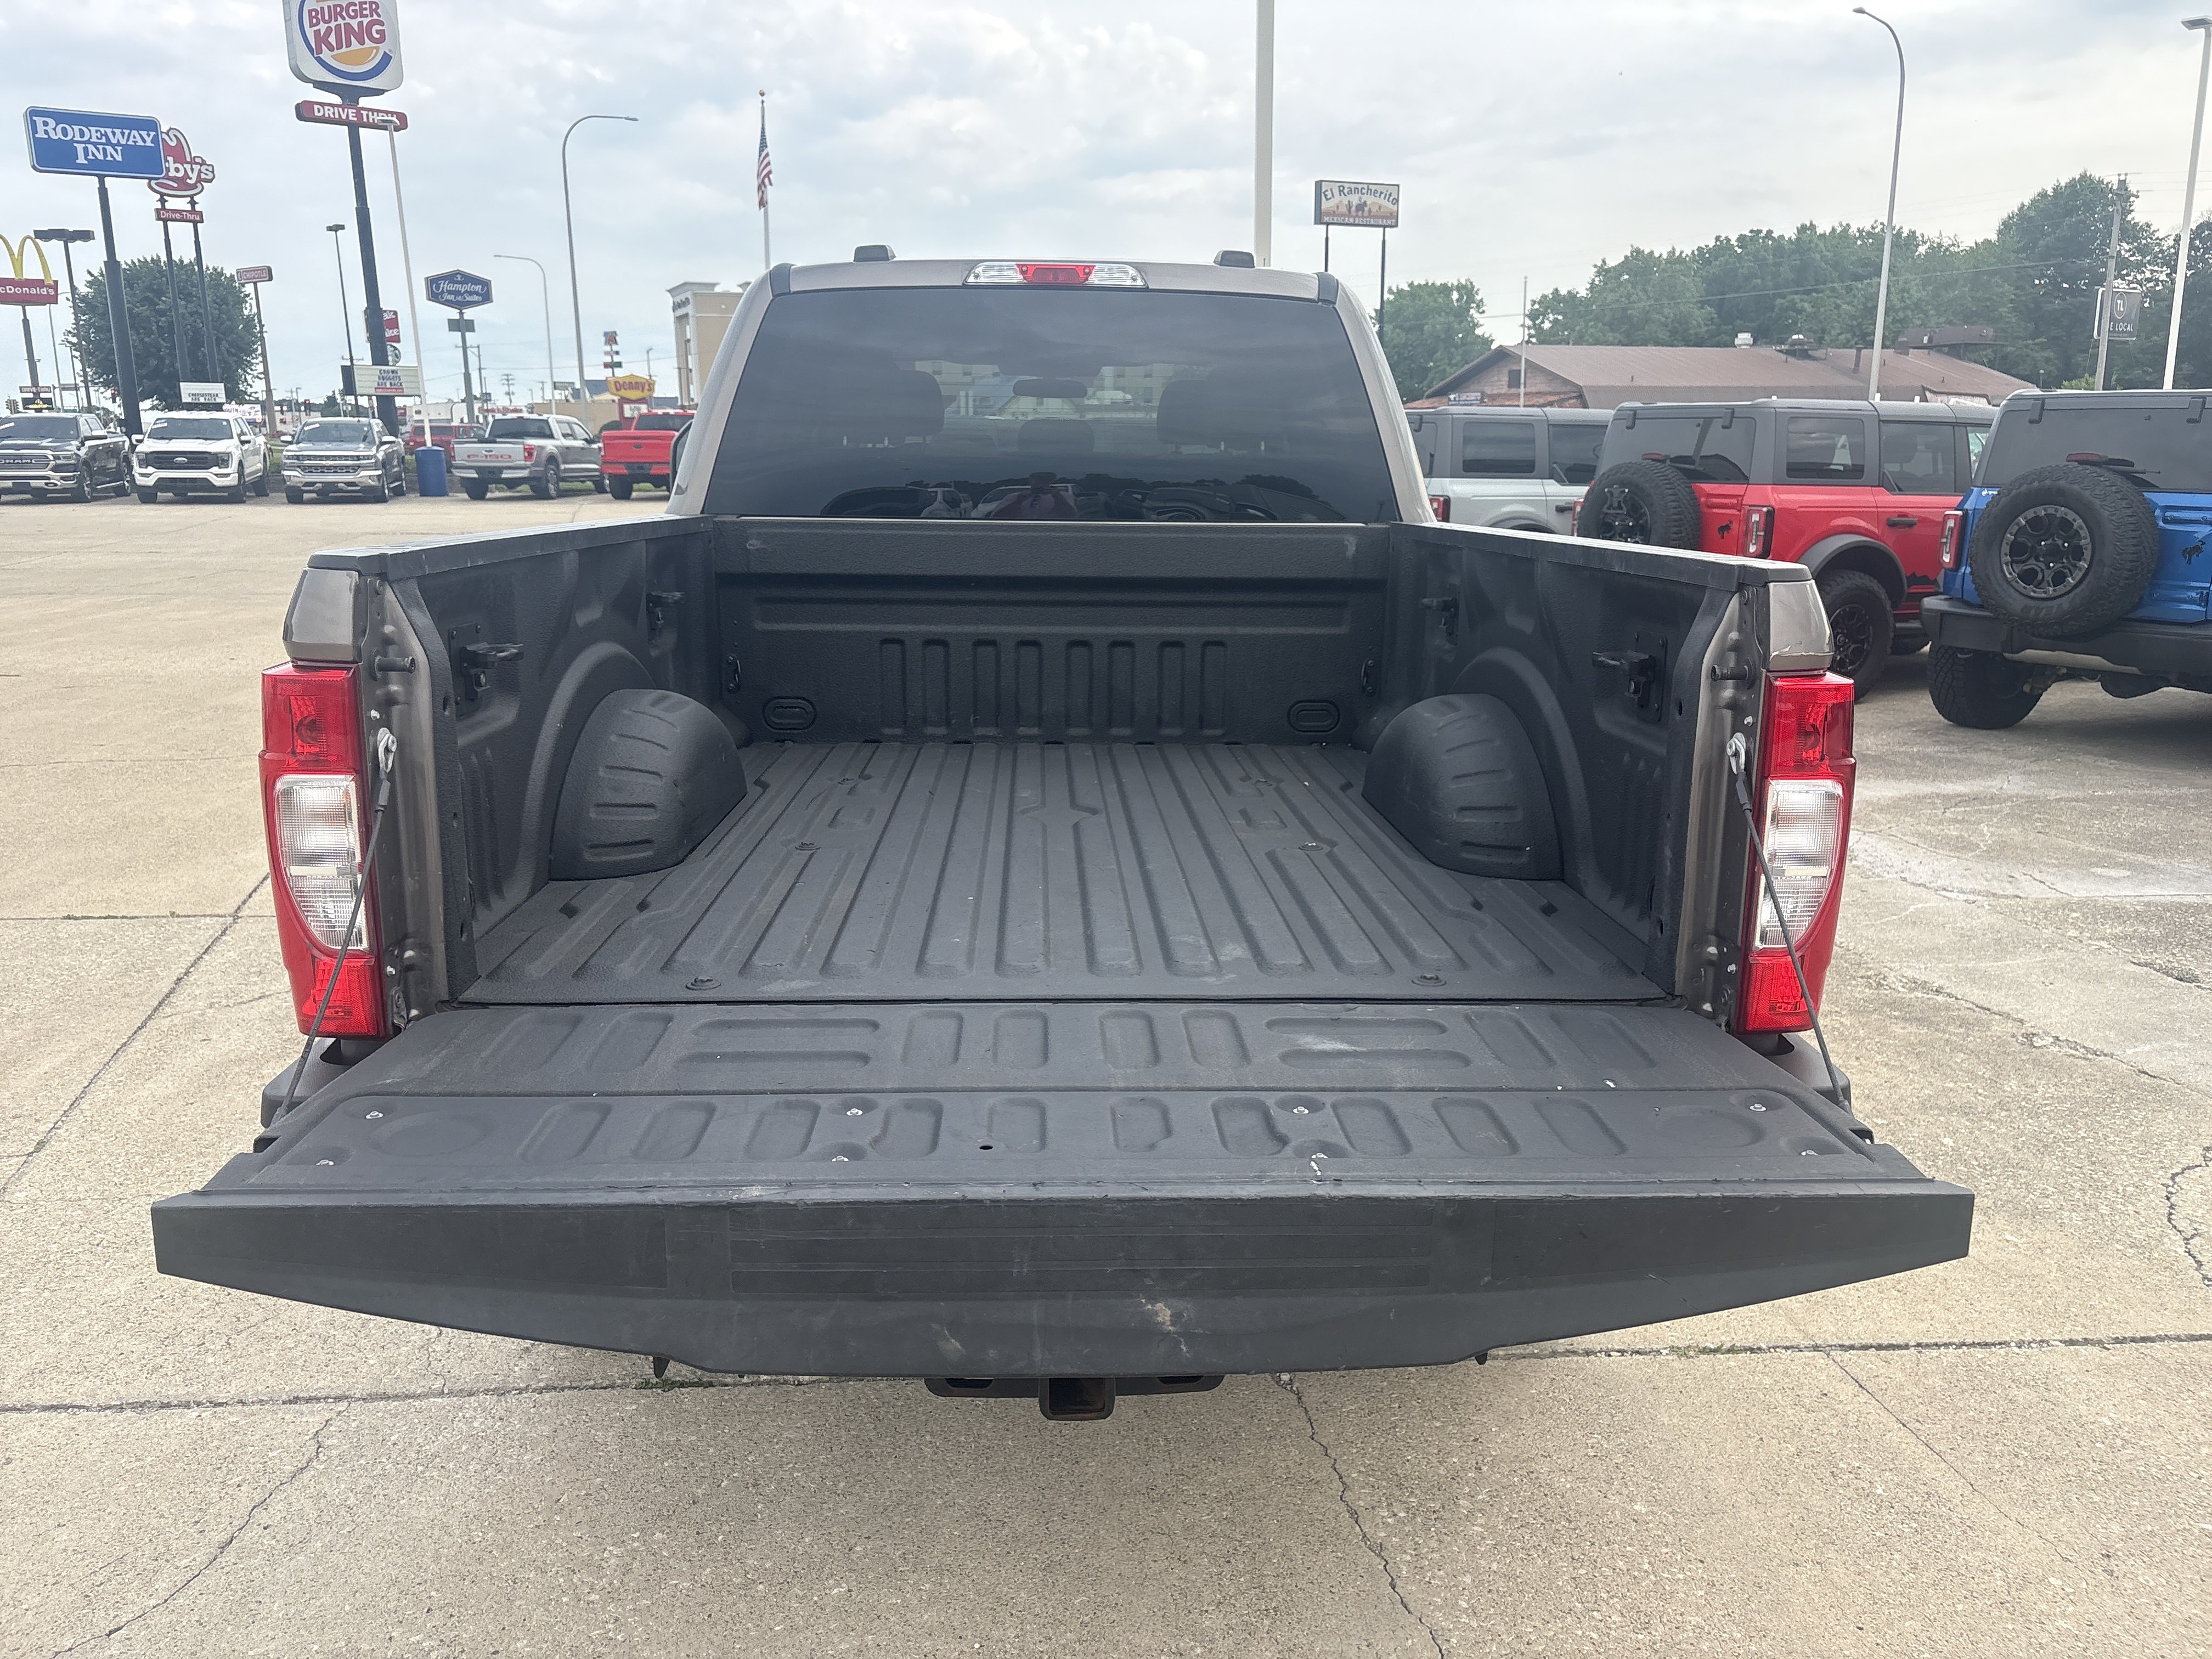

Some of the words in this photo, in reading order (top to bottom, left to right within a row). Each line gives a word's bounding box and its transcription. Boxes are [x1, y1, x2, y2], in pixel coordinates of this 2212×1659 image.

[308, 1, 381, 28] BURGER
[313, 19, 386, 55] KING
[313, 104, 357, 121] DRIVE
[32, 116, 156, 147] RODEWAY
[74, 143, 123, 164] INN
[166, 156, 215, 184] by's
[1323, 188, 1335, 201] El
[1338, 185, 1398, 206] Rancherito
[160, 210, 200, 221] Drive-Thru
[0, 285, 55, 295] cDonald's
[433, 280, 487, 294] Hampton
[438, 292, 458, 301] Inn
[2117, 299, 2124, 311] TL
[2115, 322, 2134, 332] LOCAL
[613, 380, 652, 393] Denny's
